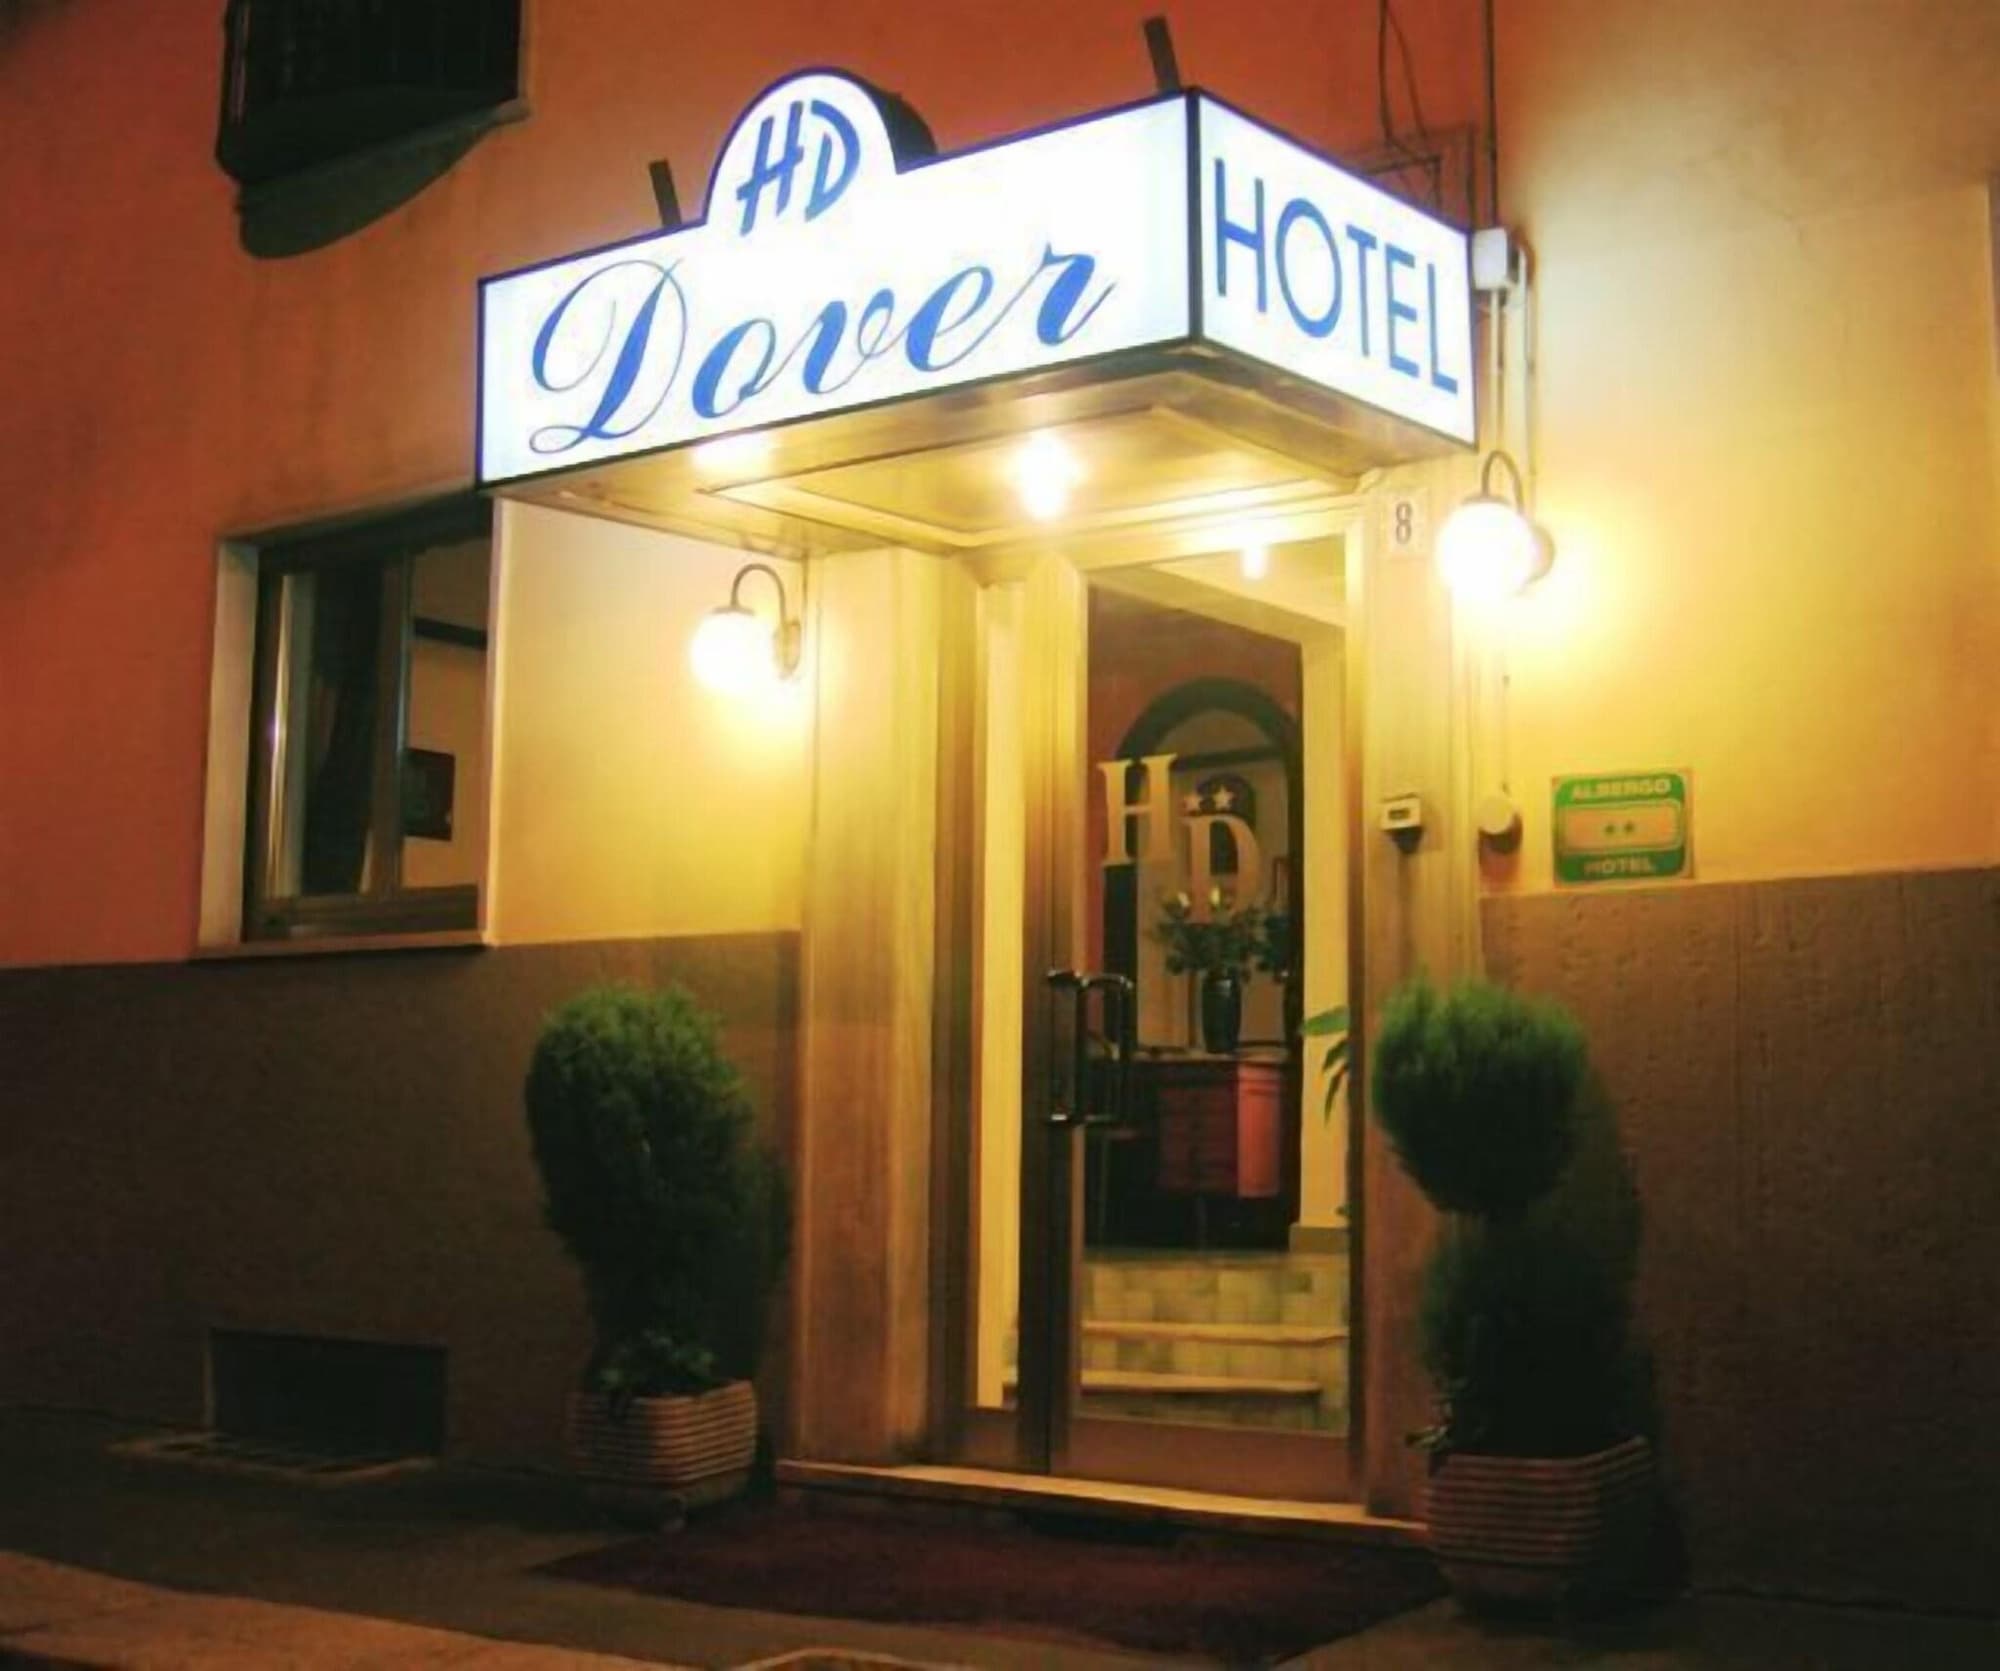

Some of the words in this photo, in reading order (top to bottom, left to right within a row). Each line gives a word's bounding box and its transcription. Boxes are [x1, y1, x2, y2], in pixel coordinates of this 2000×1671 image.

[736, 99, 861, 237] HD
[1215, 157, 1458, 394] HOTEL
[529, 243, 1117, 454] Dover
[1395, 503, 1412, 543] 8
[1584, 856, 1655, 874] HOTEL
